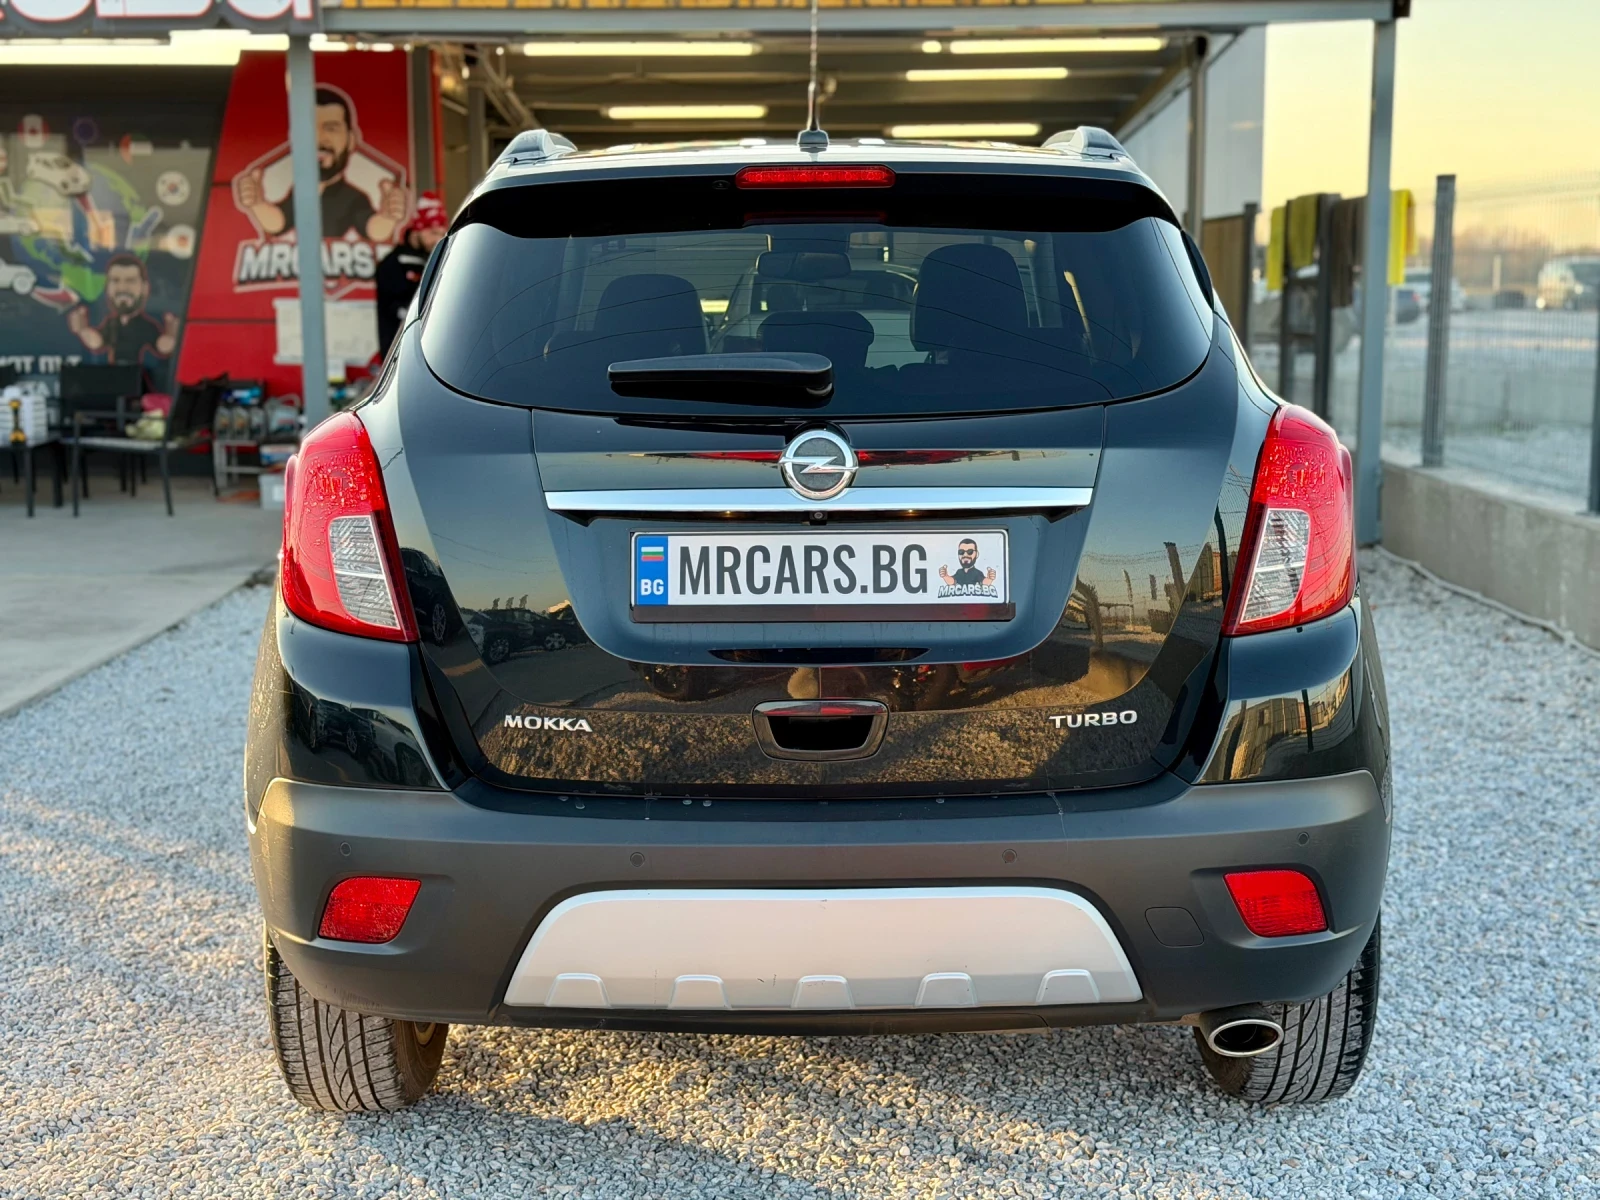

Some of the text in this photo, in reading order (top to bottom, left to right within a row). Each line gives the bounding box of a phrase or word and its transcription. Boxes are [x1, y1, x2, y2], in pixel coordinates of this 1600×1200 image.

[679, 544, 928, 596] MRCARS.BG
[640, 579, 664, 595] BG
[938, 583, 998, 598] MRCARS.BG
[504, 714, 593, 733] MOKKA
[1048, 709, 1138, 729] TURBO
